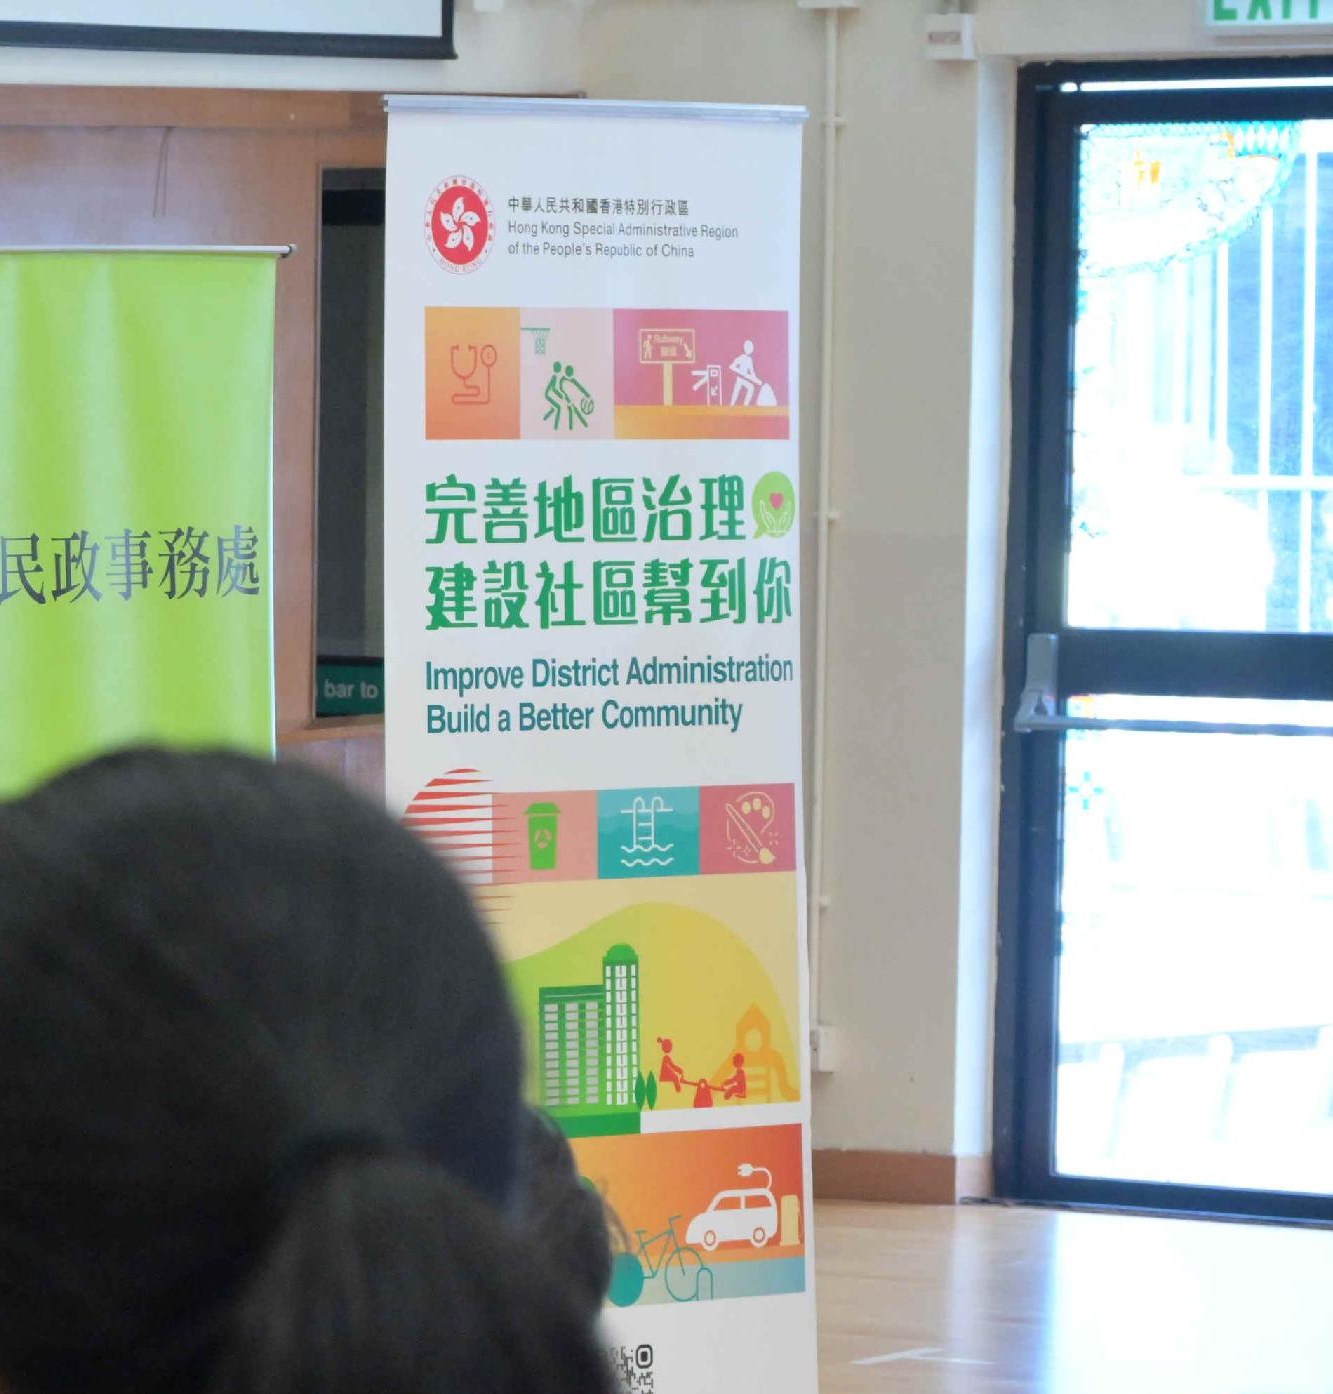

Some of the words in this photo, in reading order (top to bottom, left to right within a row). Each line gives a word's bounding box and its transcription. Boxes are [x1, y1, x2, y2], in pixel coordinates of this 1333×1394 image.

[508, 196, 689, 217] 中華人民共和國香港特別行政區
[508, 221, 538, 236] Hong
[541, 222, 570, 237] Kong
[573, 222, 615, 237] Special
[618, 223, 698, 238] Administrative
[700, 225, 739, 240] Region
[508, 242, 520, 255] of
[523, 242, 540, 255] the
[543, 242, 592, 258] People's
[595, 243, 643, 258] Republic
[646, 244, 658, 257] of
[661, 244, 695, 258] China
[425, 473, 747, 544] 完善地區治理
[425, 555, 793, 631] 建設社區幫到你
[324, 680, 354, 698] bar
[360, 681, 379, 698] to
[425, 659, 524, 697] Improve
[532, 657, 619, 688] District
[626, 653, 794, 685] Administration
[427, 703, 490, 734] Build
[498, 710, 511, 732] a
[519, 701, 594, 732] Better
[601, 696, 744, 733] Community
